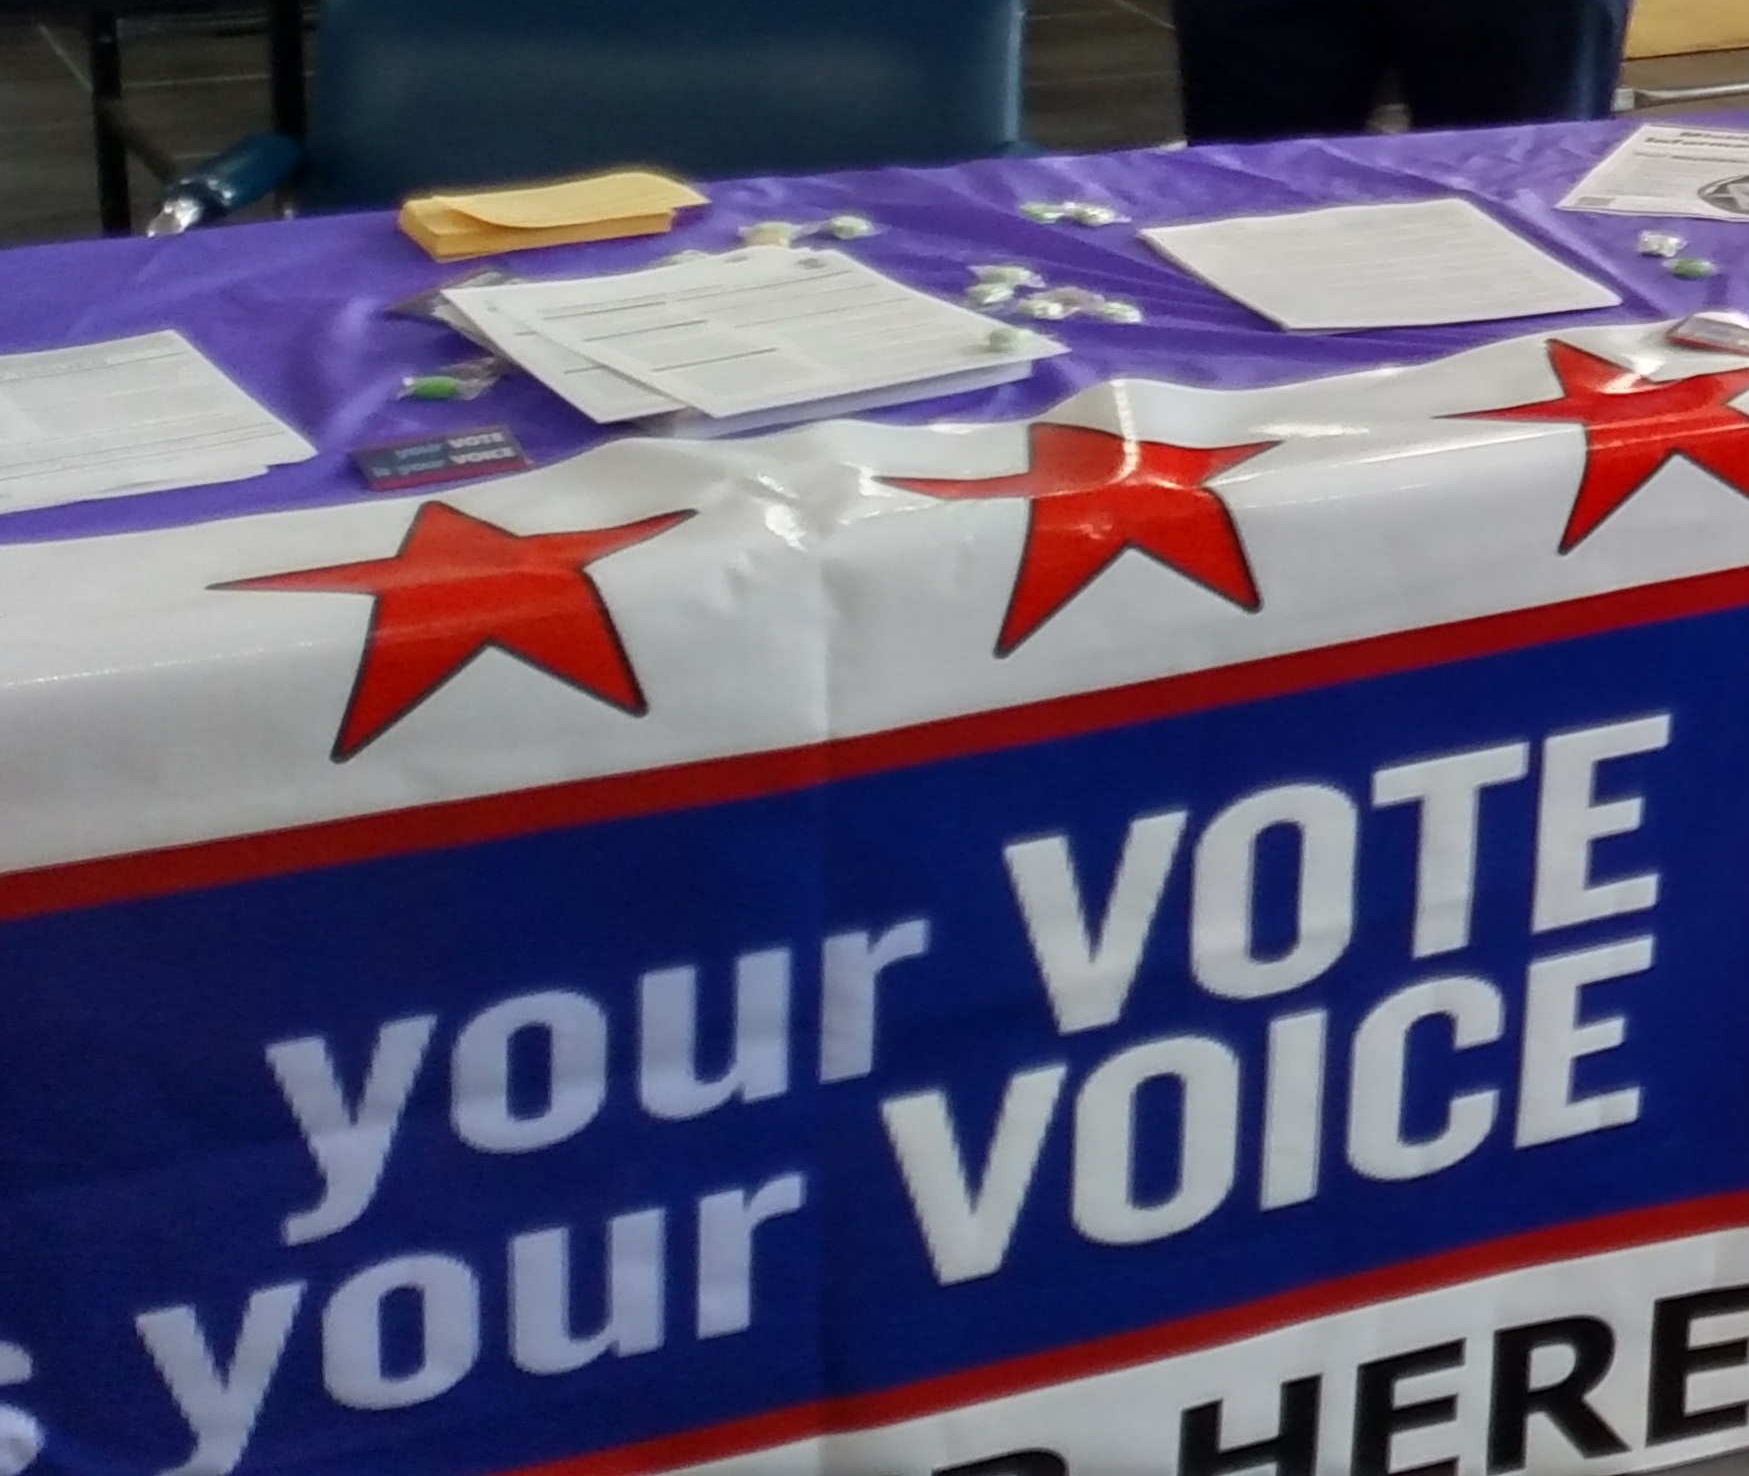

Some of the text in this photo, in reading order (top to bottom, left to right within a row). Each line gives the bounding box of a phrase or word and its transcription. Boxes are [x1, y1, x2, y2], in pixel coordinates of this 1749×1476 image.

[448, 432, 504, 448] VOTE
[134, 1172, 806, 1476] your
[880, 936, 1656, 1287] VOICE
[266, 714, 1673, 1246] your VOTE
